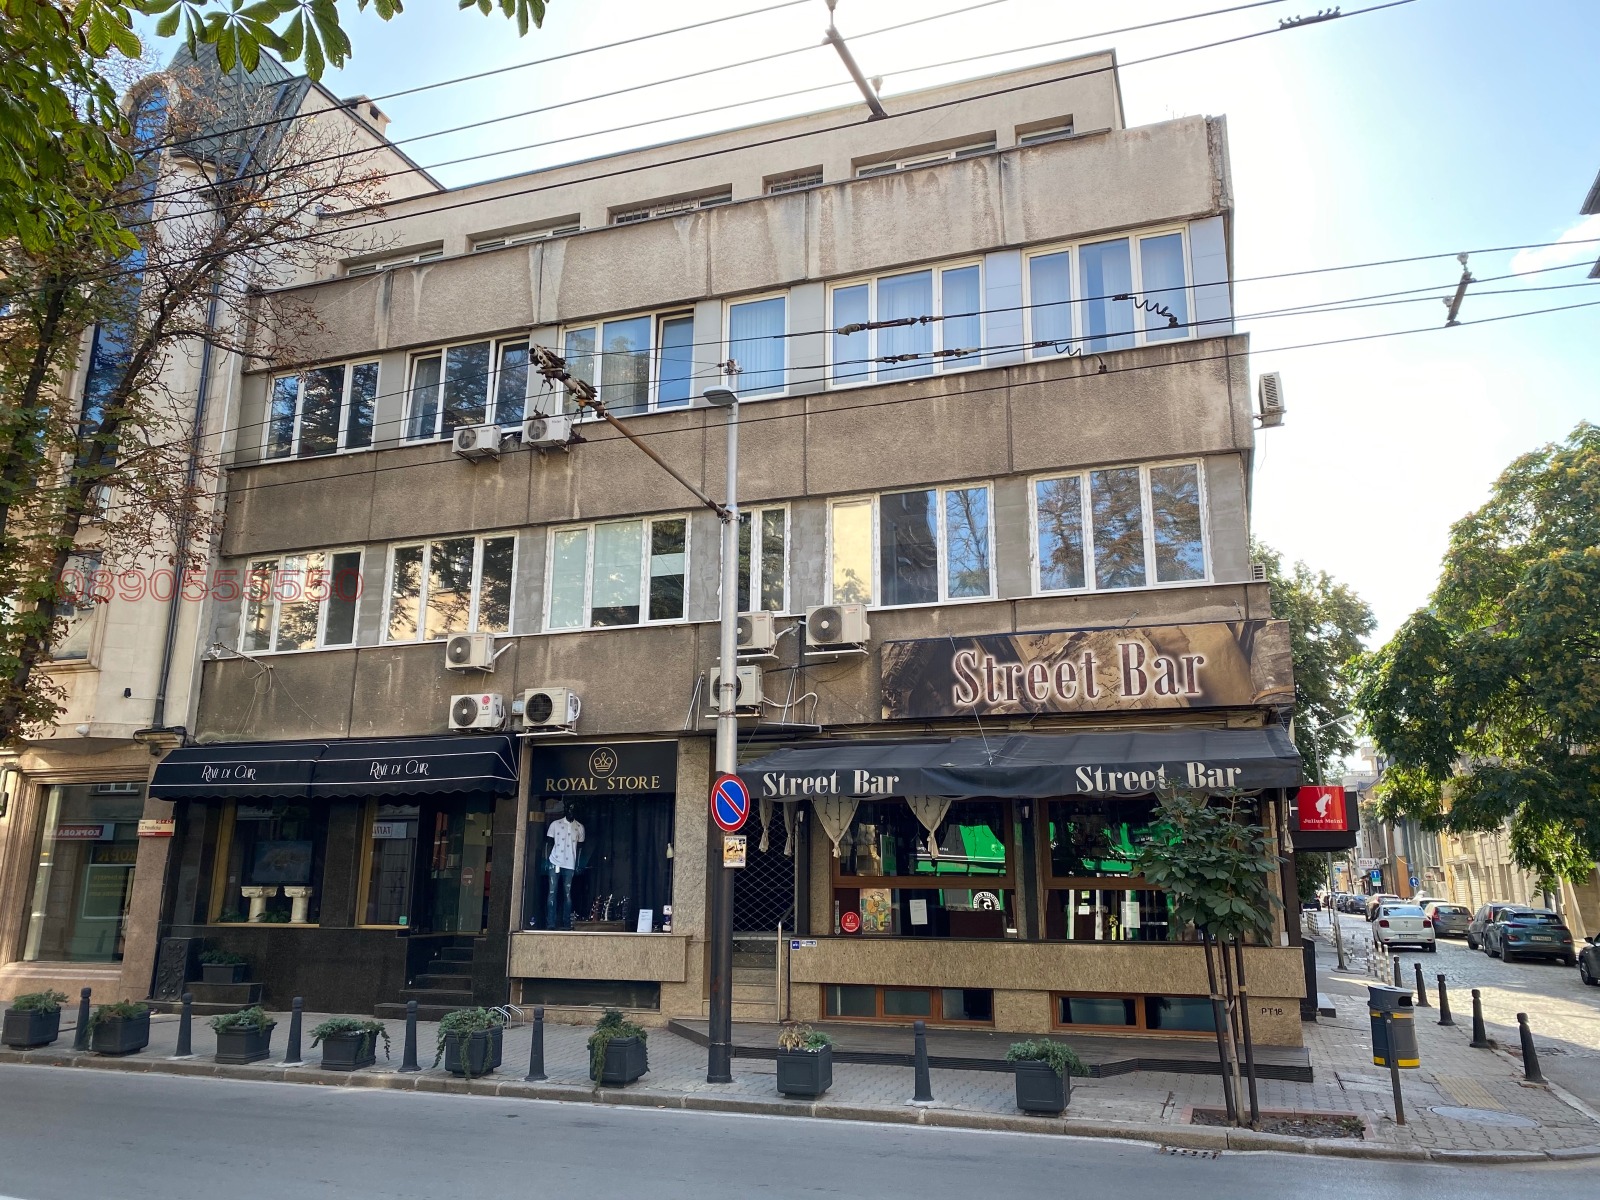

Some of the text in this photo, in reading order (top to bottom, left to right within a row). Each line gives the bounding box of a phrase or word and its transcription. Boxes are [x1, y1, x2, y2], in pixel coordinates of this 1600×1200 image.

[953, 642, 1205, 704] Street Bar
[545, 775, 661, 792] ROYAL STORE
[762, 769, 900, 797] Street Bar
[1075, 762, 1242, 793] Street Bar
[1261, 1007, 1284, 1016] PT18
